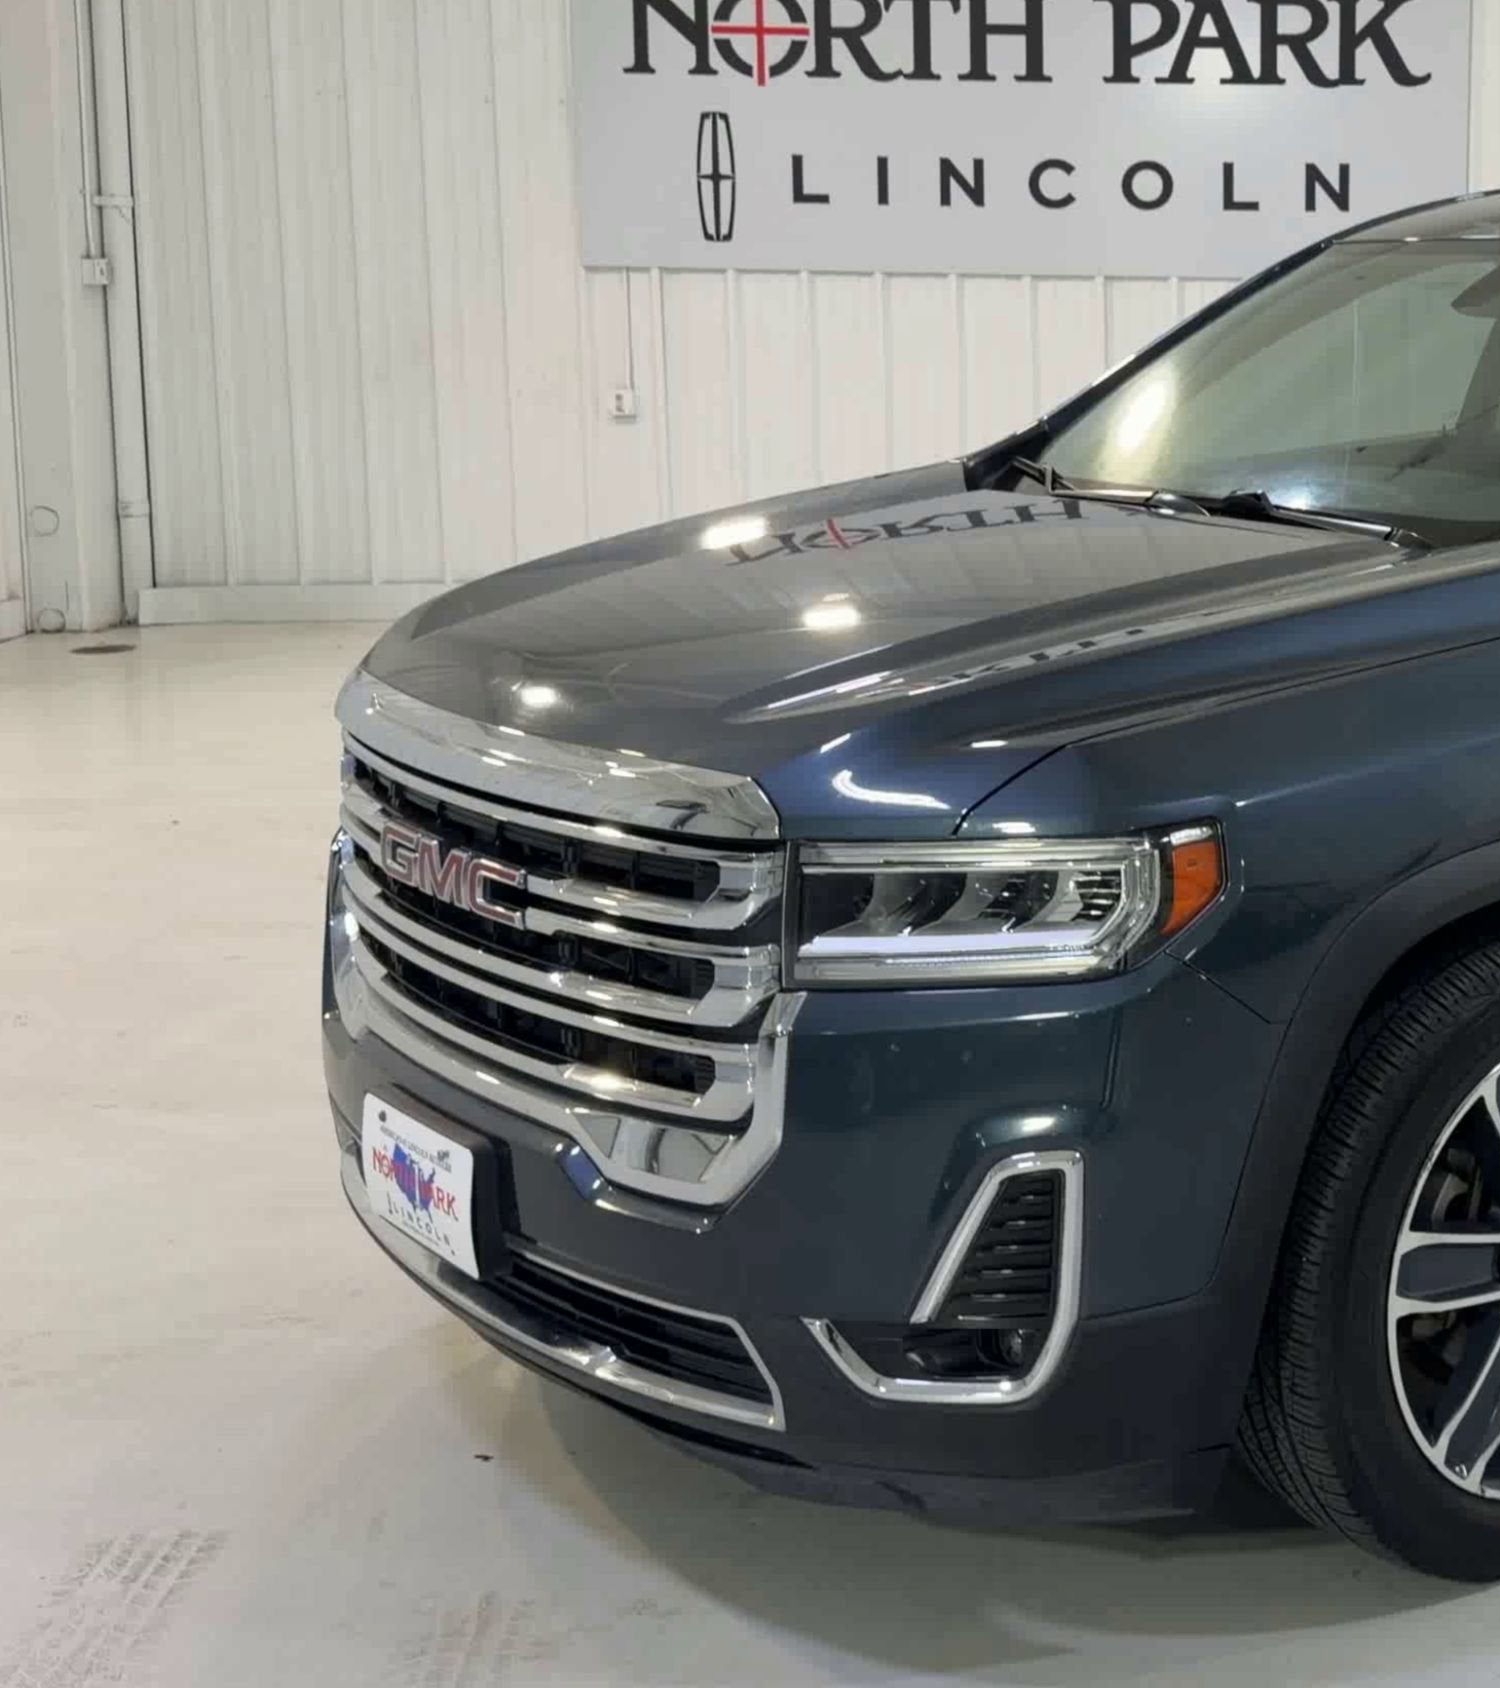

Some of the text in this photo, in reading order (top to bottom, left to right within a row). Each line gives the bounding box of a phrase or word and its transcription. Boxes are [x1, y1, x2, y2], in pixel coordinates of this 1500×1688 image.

[623, 0, 1431, 88] NORTH PARK
[791, 154, 1352, 213] LINCOLN
[381, 820, 526, 930] GMC
[371, 1145, 415, 1196] NOR
[420, 1172, 460, 1222] ARK
[393, 1201, 451, 1247] LINCOLN
